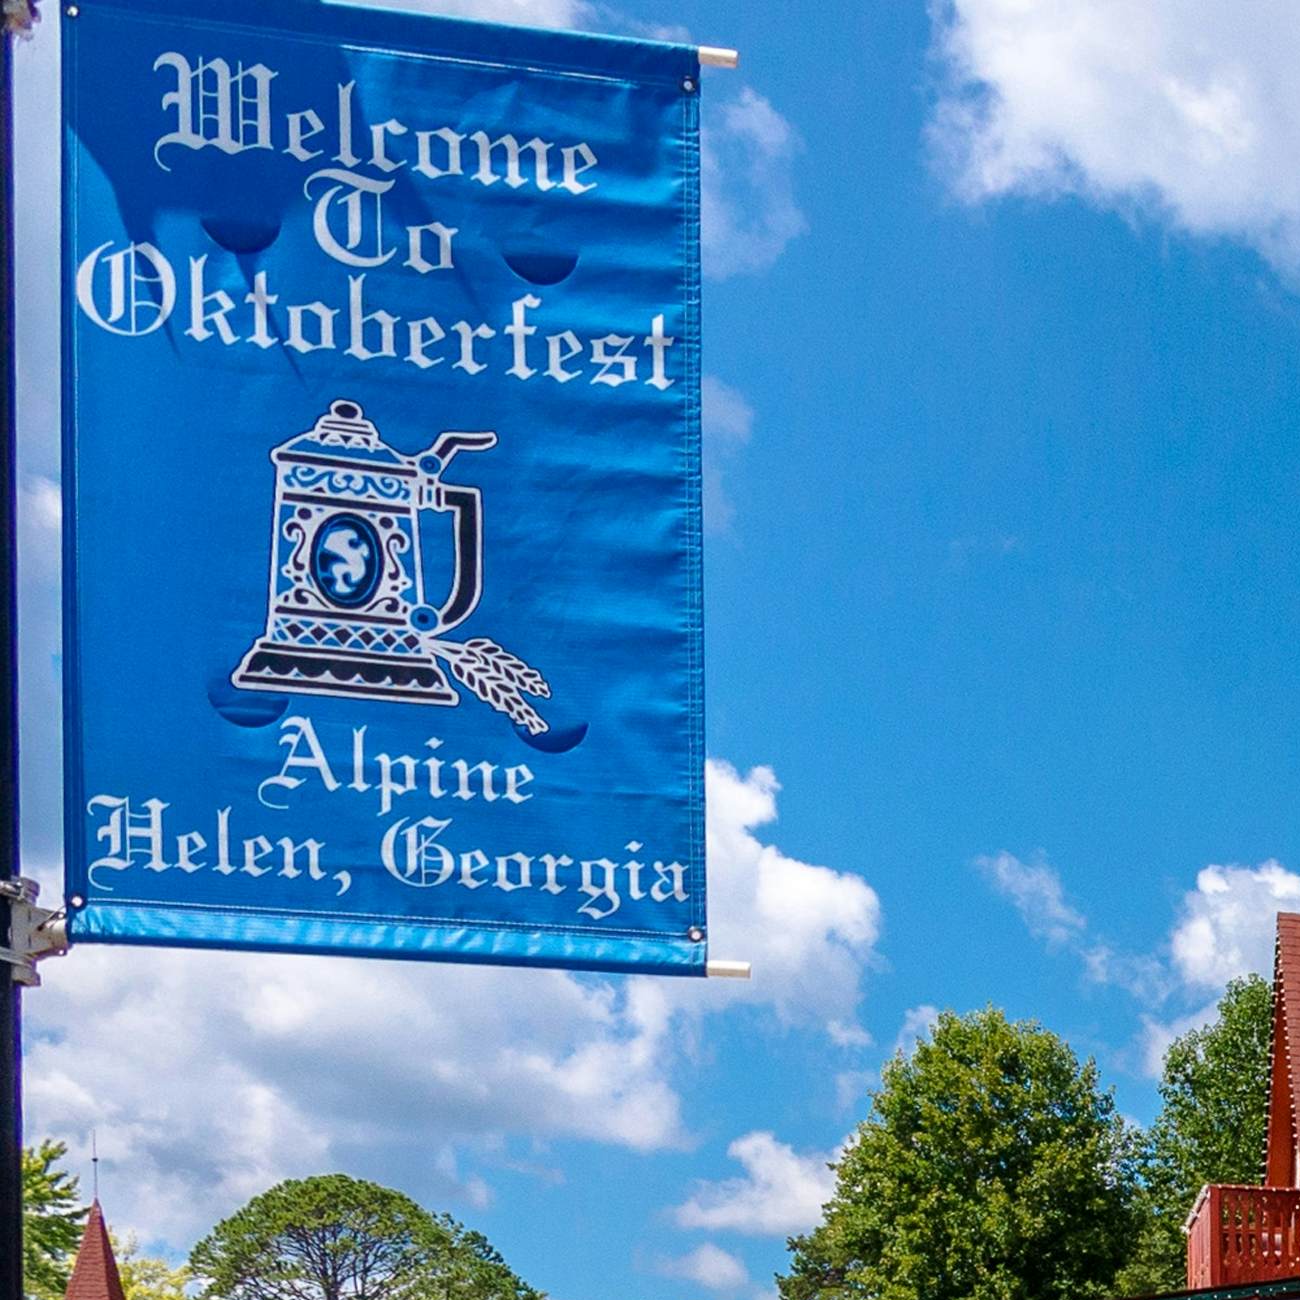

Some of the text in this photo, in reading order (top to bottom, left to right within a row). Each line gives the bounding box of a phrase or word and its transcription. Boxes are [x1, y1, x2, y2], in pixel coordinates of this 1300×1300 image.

[154, 51, 599, 196] Welcome
[303, 170, 454, 274] To
[76, 240, 675, 391] Oktoberfest
[258, 716, 535, 818] Alpine
[87, 794, 690, 919] Helen, Georgia
